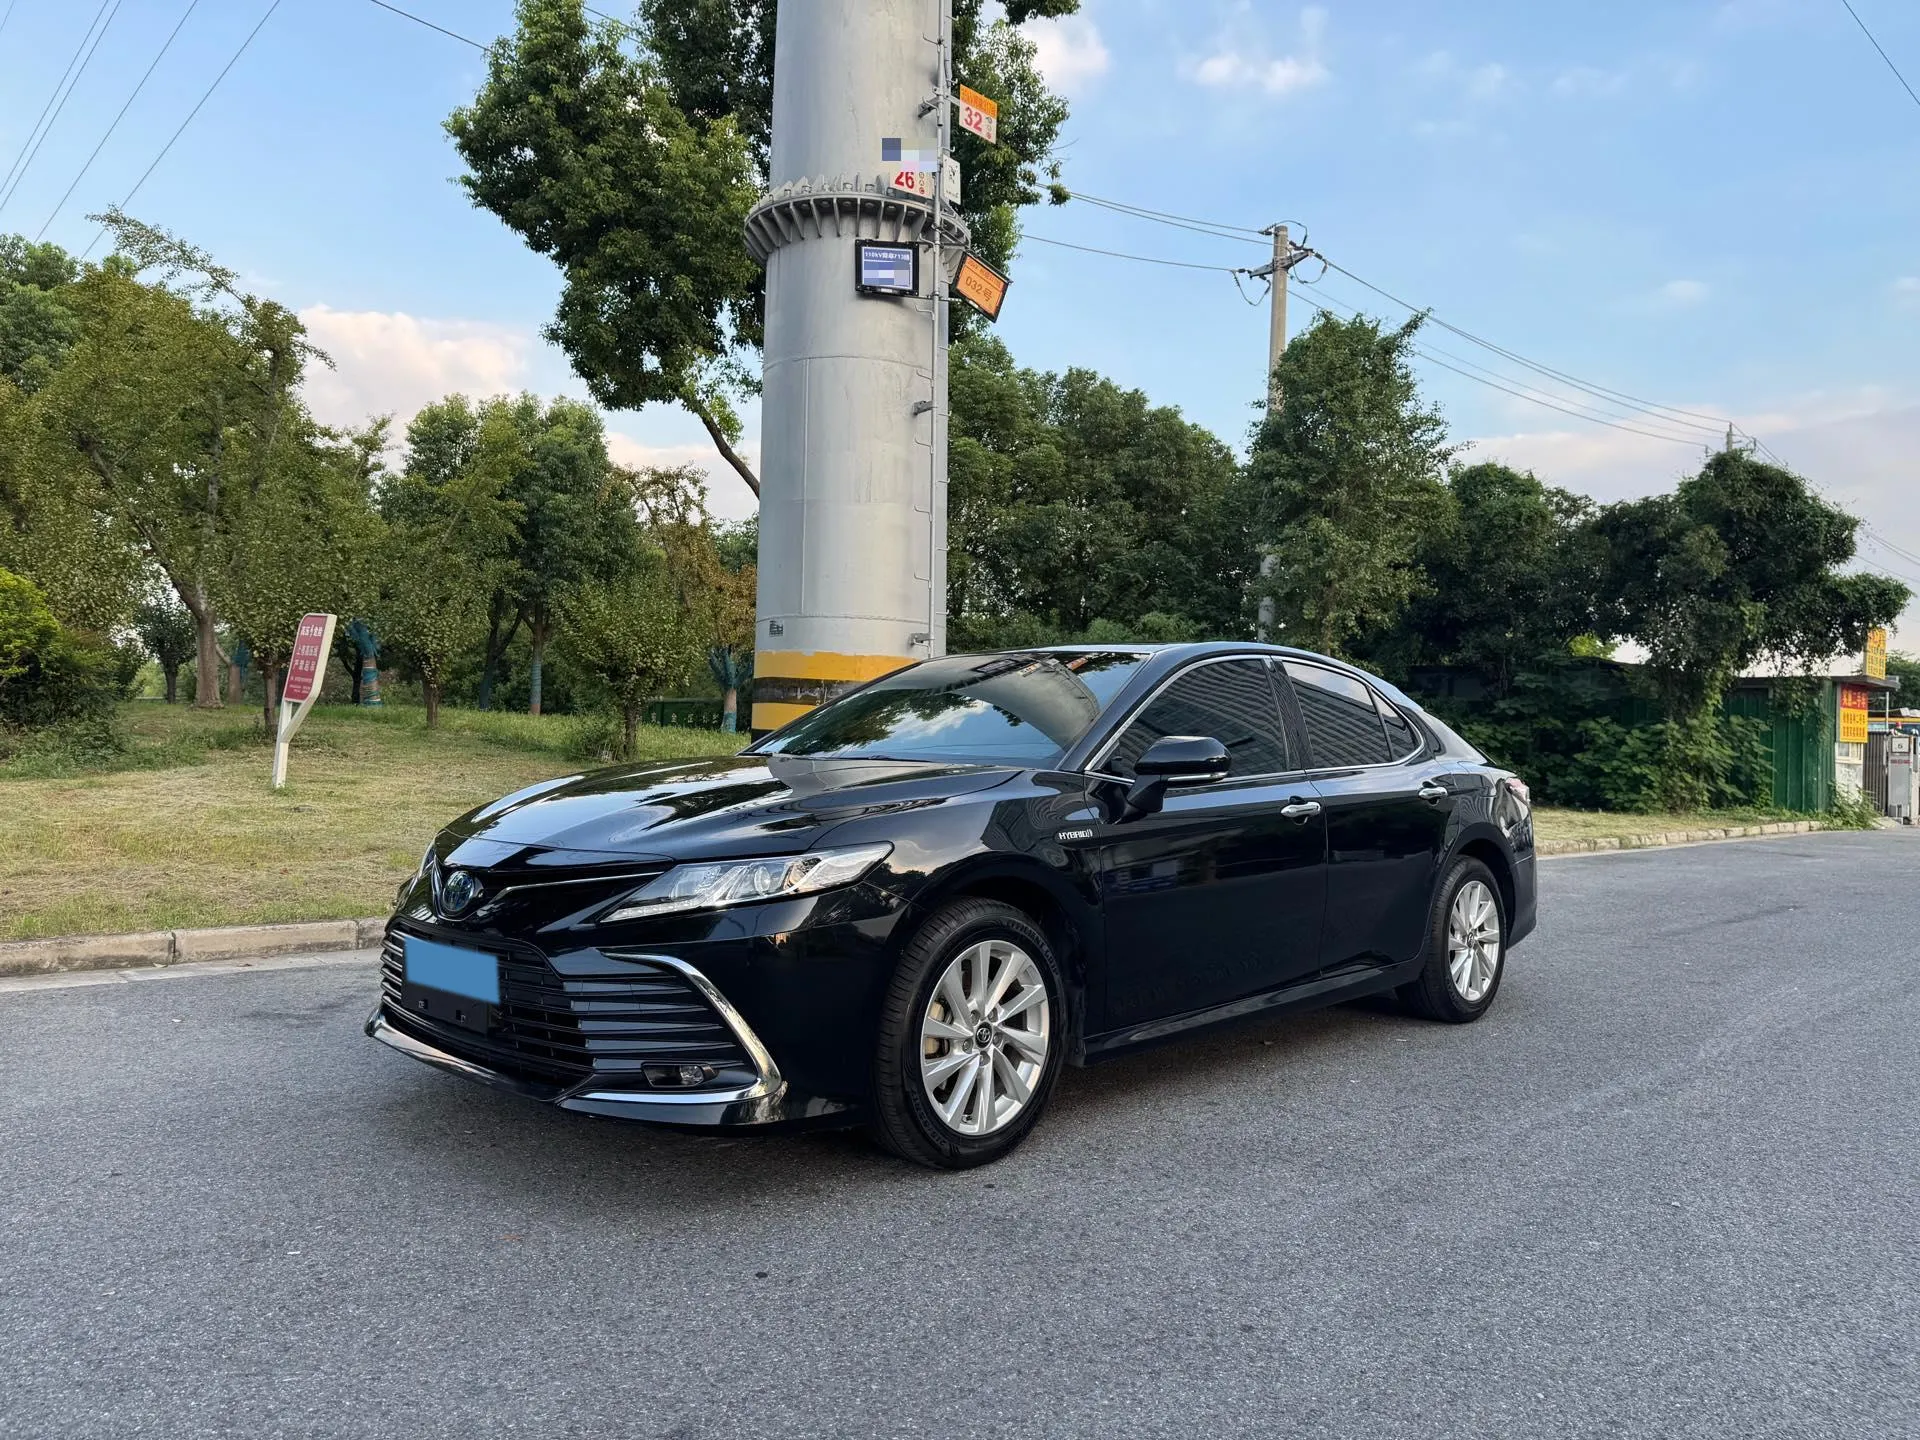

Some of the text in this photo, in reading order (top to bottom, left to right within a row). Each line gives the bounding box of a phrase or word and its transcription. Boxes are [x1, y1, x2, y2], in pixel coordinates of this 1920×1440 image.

[965, 107, 982, 132] 32
[895, 172, 914, 189] 26
[966, 276, 992, 301] 032号
[1059, 830, 1087, 840] HYBRID
